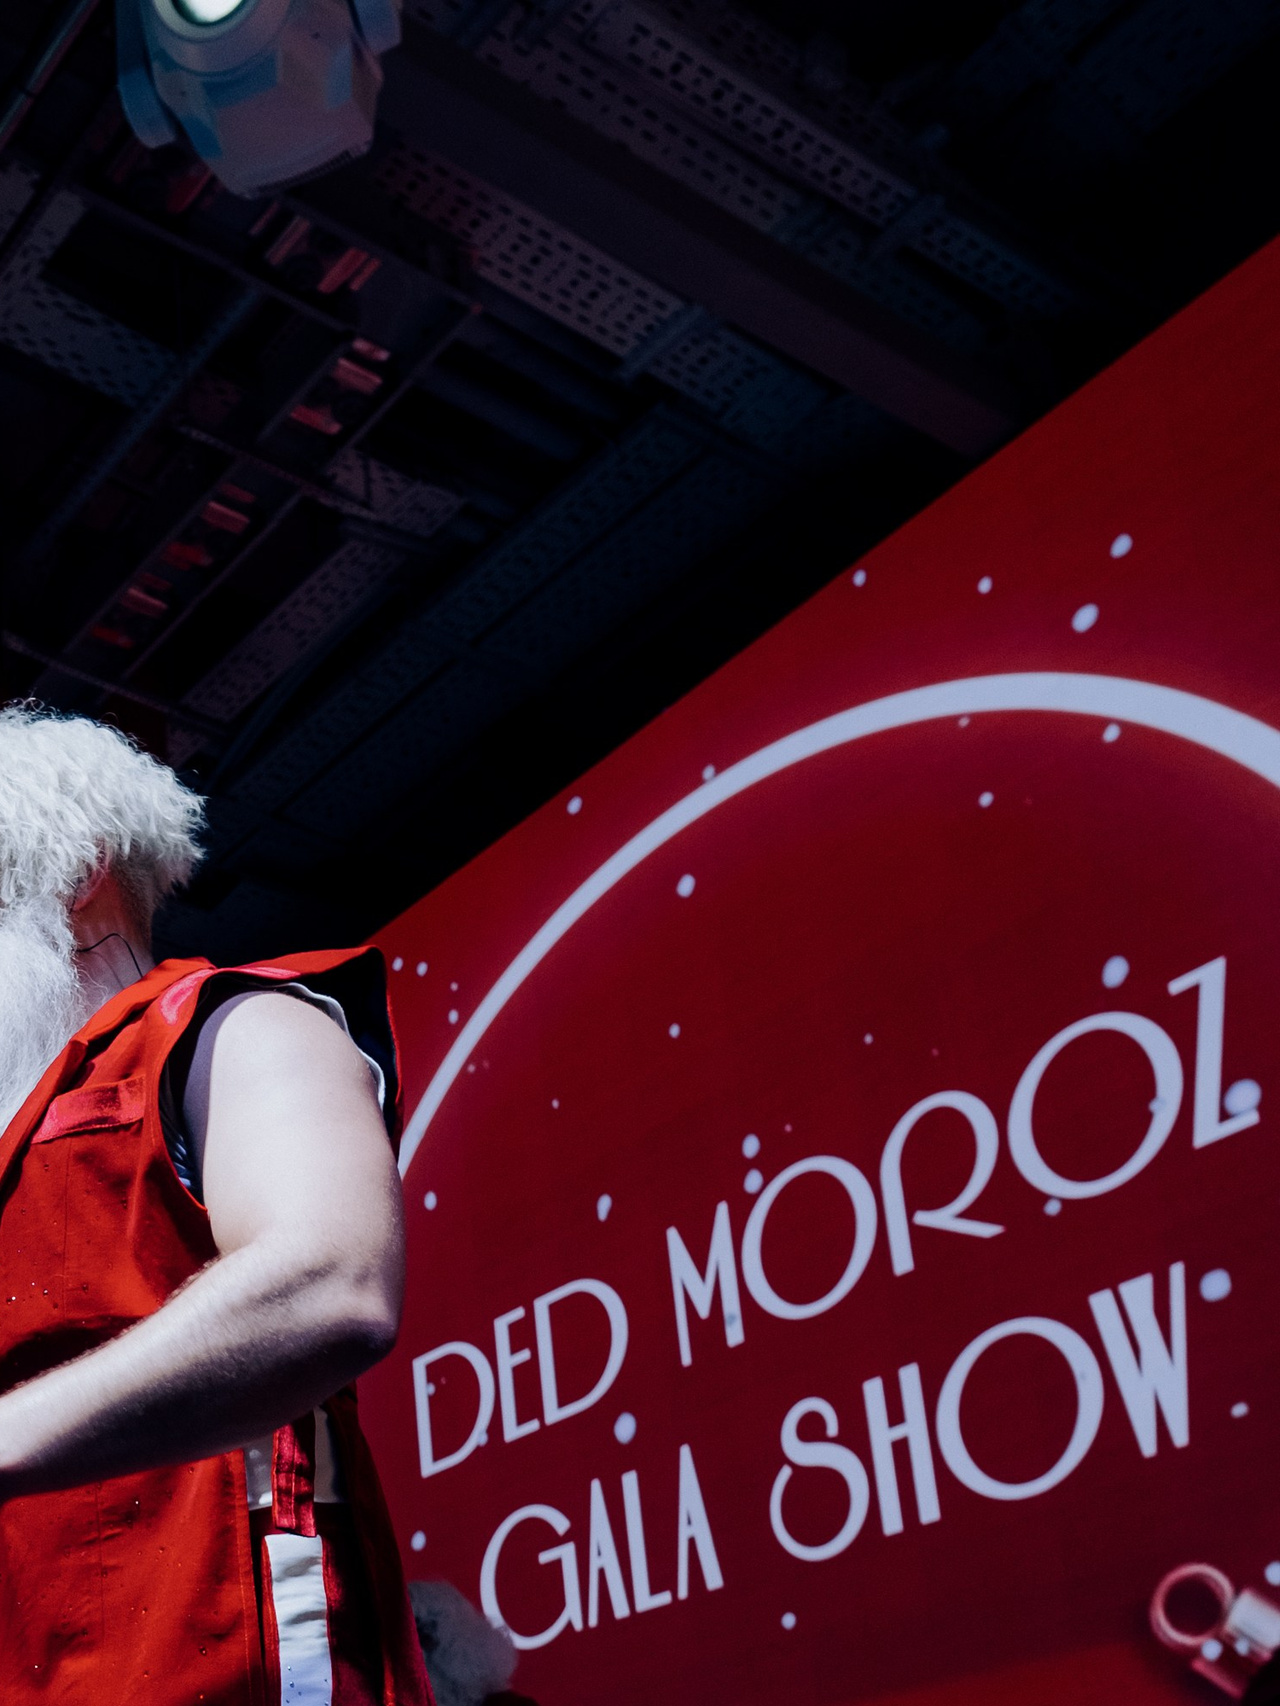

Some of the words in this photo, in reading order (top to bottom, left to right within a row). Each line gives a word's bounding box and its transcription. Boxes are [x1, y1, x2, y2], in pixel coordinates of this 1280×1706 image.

[412, 1278, 628, 1478] DED
[666, 956, 1261, 1367] MOROZ
[479, 1444, 724, 1651] GALA
[770, 1261, 1190, 1562] SHOW
